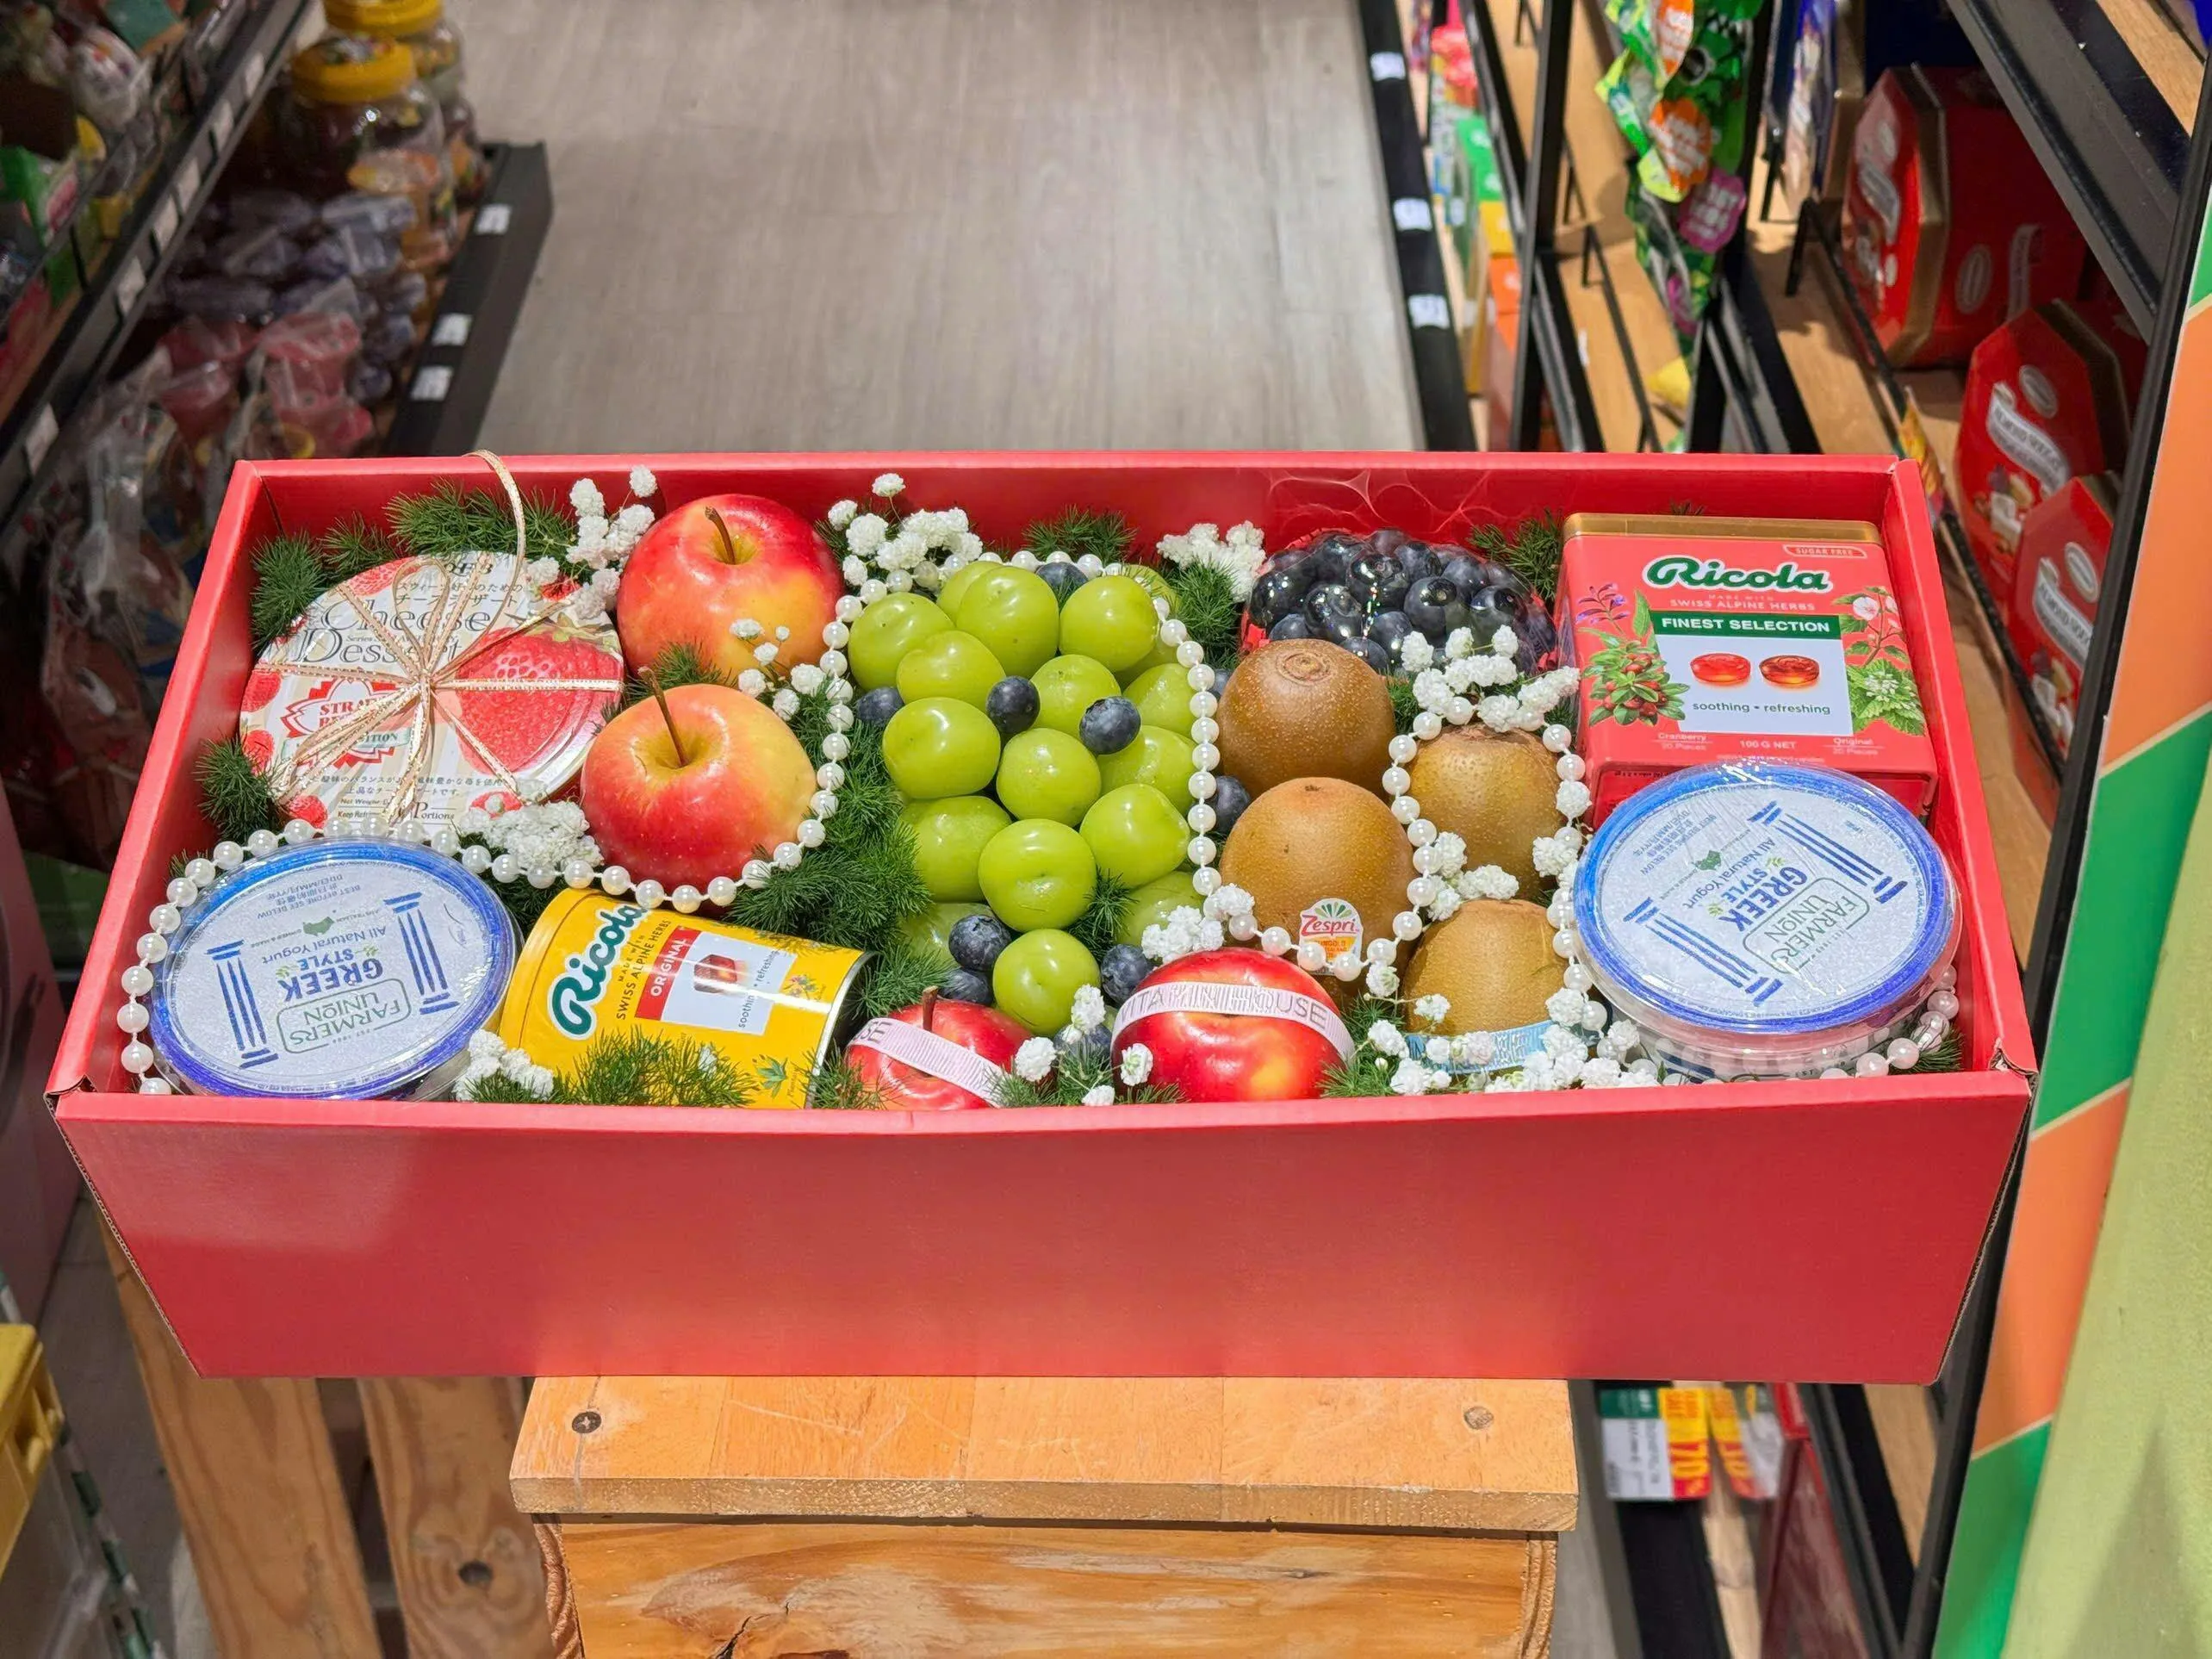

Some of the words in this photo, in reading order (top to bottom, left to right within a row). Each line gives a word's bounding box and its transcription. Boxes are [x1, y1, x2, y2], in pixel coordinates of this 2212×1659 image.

[1796, 547, 1828, 556] SUGAR
[1830, 548, 1853, 556] FREE
[1645, 555, 1830, 592] Ricola
[320, 599, 491, 631] Cheese
[1669, 598, 1712, 608] SWISS
[1716, 599, 1766, 609] ALPINE
[1769, 600, 1815, 611] HERBS
[1662, 618, 1724, 630] FINEST
[1729, 618, 1830, 633] SELECTION
[1692, 701, 1750, 713] soothing
[1763, 703, 1831, 716] refreshing
[1657, 731, 1707, 742] Cranberry
[1739, 739, 1759, 749] 100
[1760, 740, 1770, 749] G
[1773, 740, 1797, 750] NET
[1832, 736, 1874, 747] Original
[1758, 836, 1777, 857] All
[1724, 849, 1762, 882] Natural
[1682, 879, 1724, 910] Yogurt
[1718, 866, 1809, 933] GREEK
[1721, 867, 1768, 904] STYLE
[370, 925, 387, 939] All
[1302, 914, 1355, 936] Zespri
[1763, 894, 1836, 943] UNION
[1770, 895, 1859, 964] FARMERS
[261, 944, 312, 965] Yogurt
[313, 929, 366, 951] Natural
[296, 948, 355, 971] STYLE
[550, 904, 649, 1037] Ricola
[615, 982, 637, 1021] SWISS
[631, 942, 655, 982] ALPINE
[650, 919, 671, 946] HERBS
[649, 937, 689, 997] ORIGINAL
[277, 958, 384, 1003] GREEK
[738, 992, 755, 1029] soothin
[755, 949, 780, 984] refreshing
[289, 998, 401, 1046] FARMERS
[302, 991, 381, 1026] UNION
[1230, 985, 1327, 1030] HOUSE
